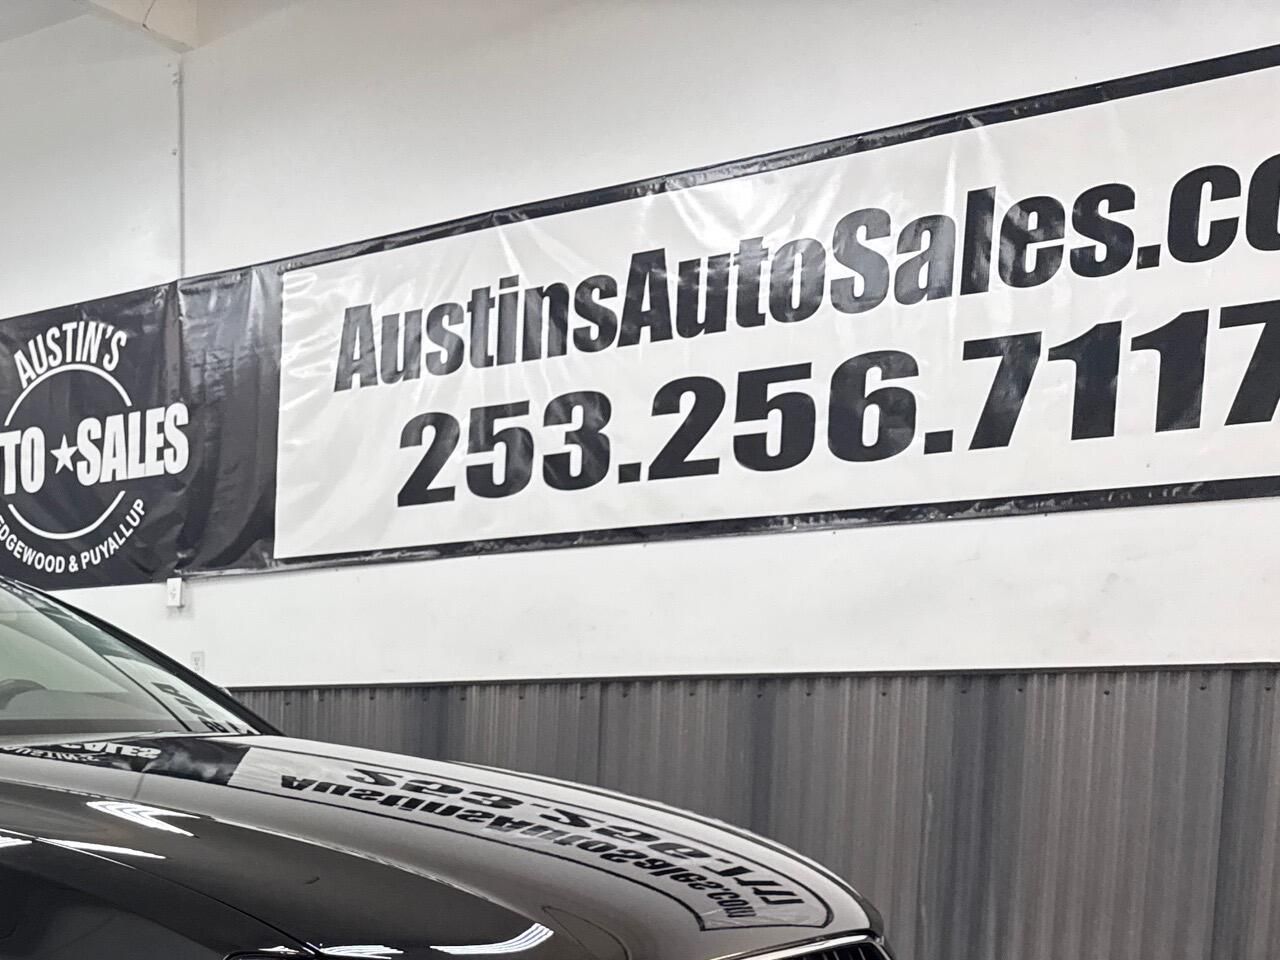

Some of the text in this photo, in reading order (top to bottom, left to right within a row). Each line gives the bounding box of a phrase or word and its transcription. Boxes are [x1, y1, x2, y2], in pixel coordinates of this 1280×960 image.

[14, 321, 128, 389] AUSTIN'S
[397, 299, 1280, 507] 253.256.7117
[76, 402, 189, 486] SALES
[69, 555, 79, 573] &
[81, 498, 146, 570] PUYALLUP
